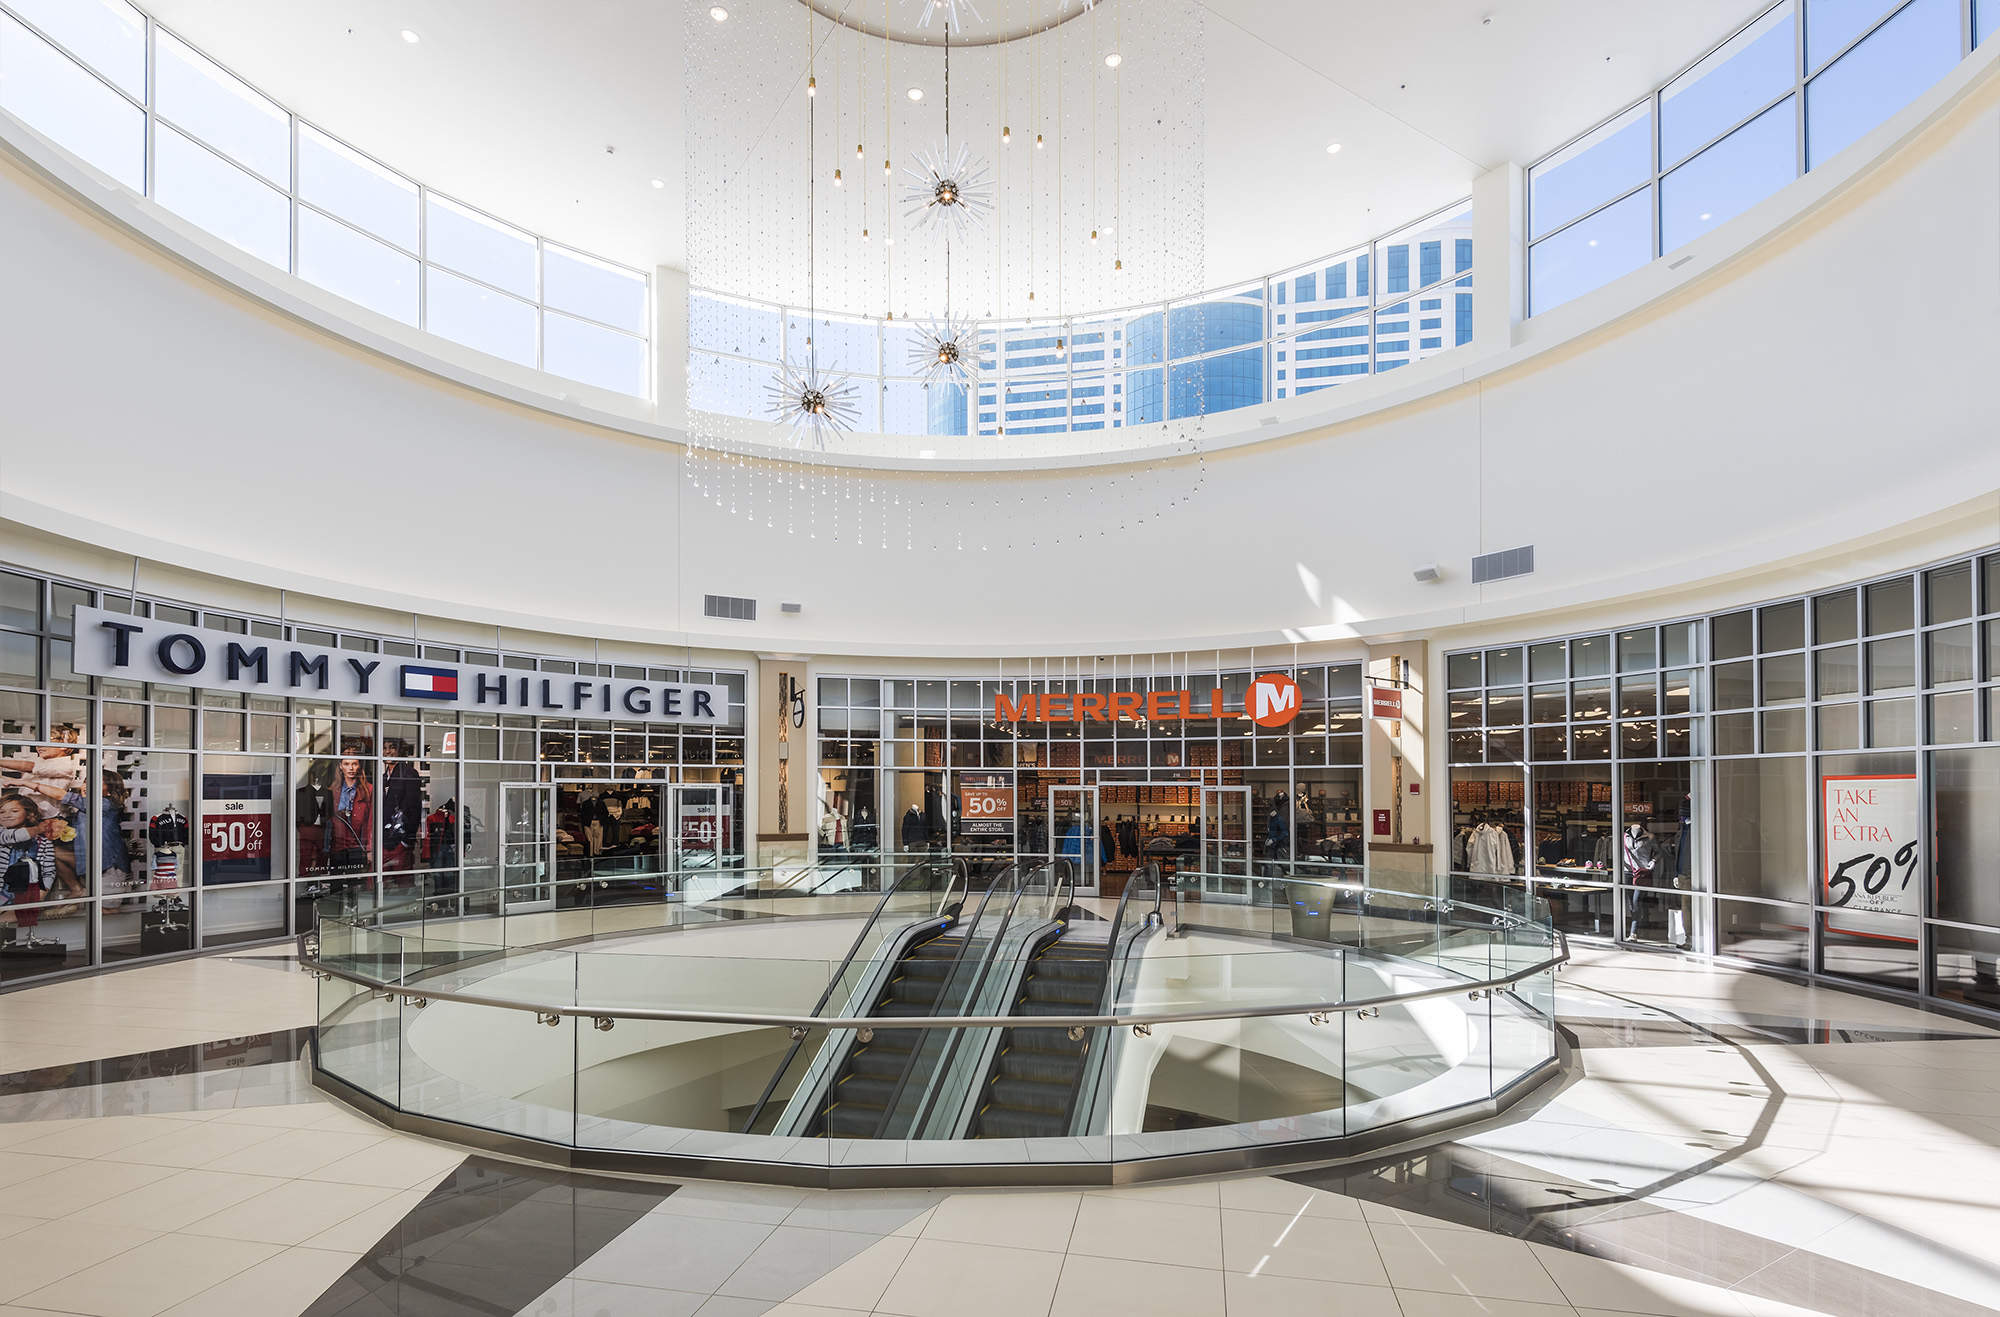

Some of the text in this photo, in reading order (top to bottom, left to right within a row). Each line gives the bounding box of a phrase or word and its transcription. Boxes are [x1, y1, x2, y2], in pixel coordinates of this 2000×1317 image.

[101, 620, 716, 718] TOMMY HILFIGER
[994, 687, 1243, 723] MERRELL
[1832, 788, 1879, 805] TAKE
[225, 801, 244, 811] sale
[1832, 807, 1859, 823] AN
[1832, 825, 1893, 843] EXTRA
[246, 839, 263, 851] off
[1840, 891, 1866, 899] BANA
